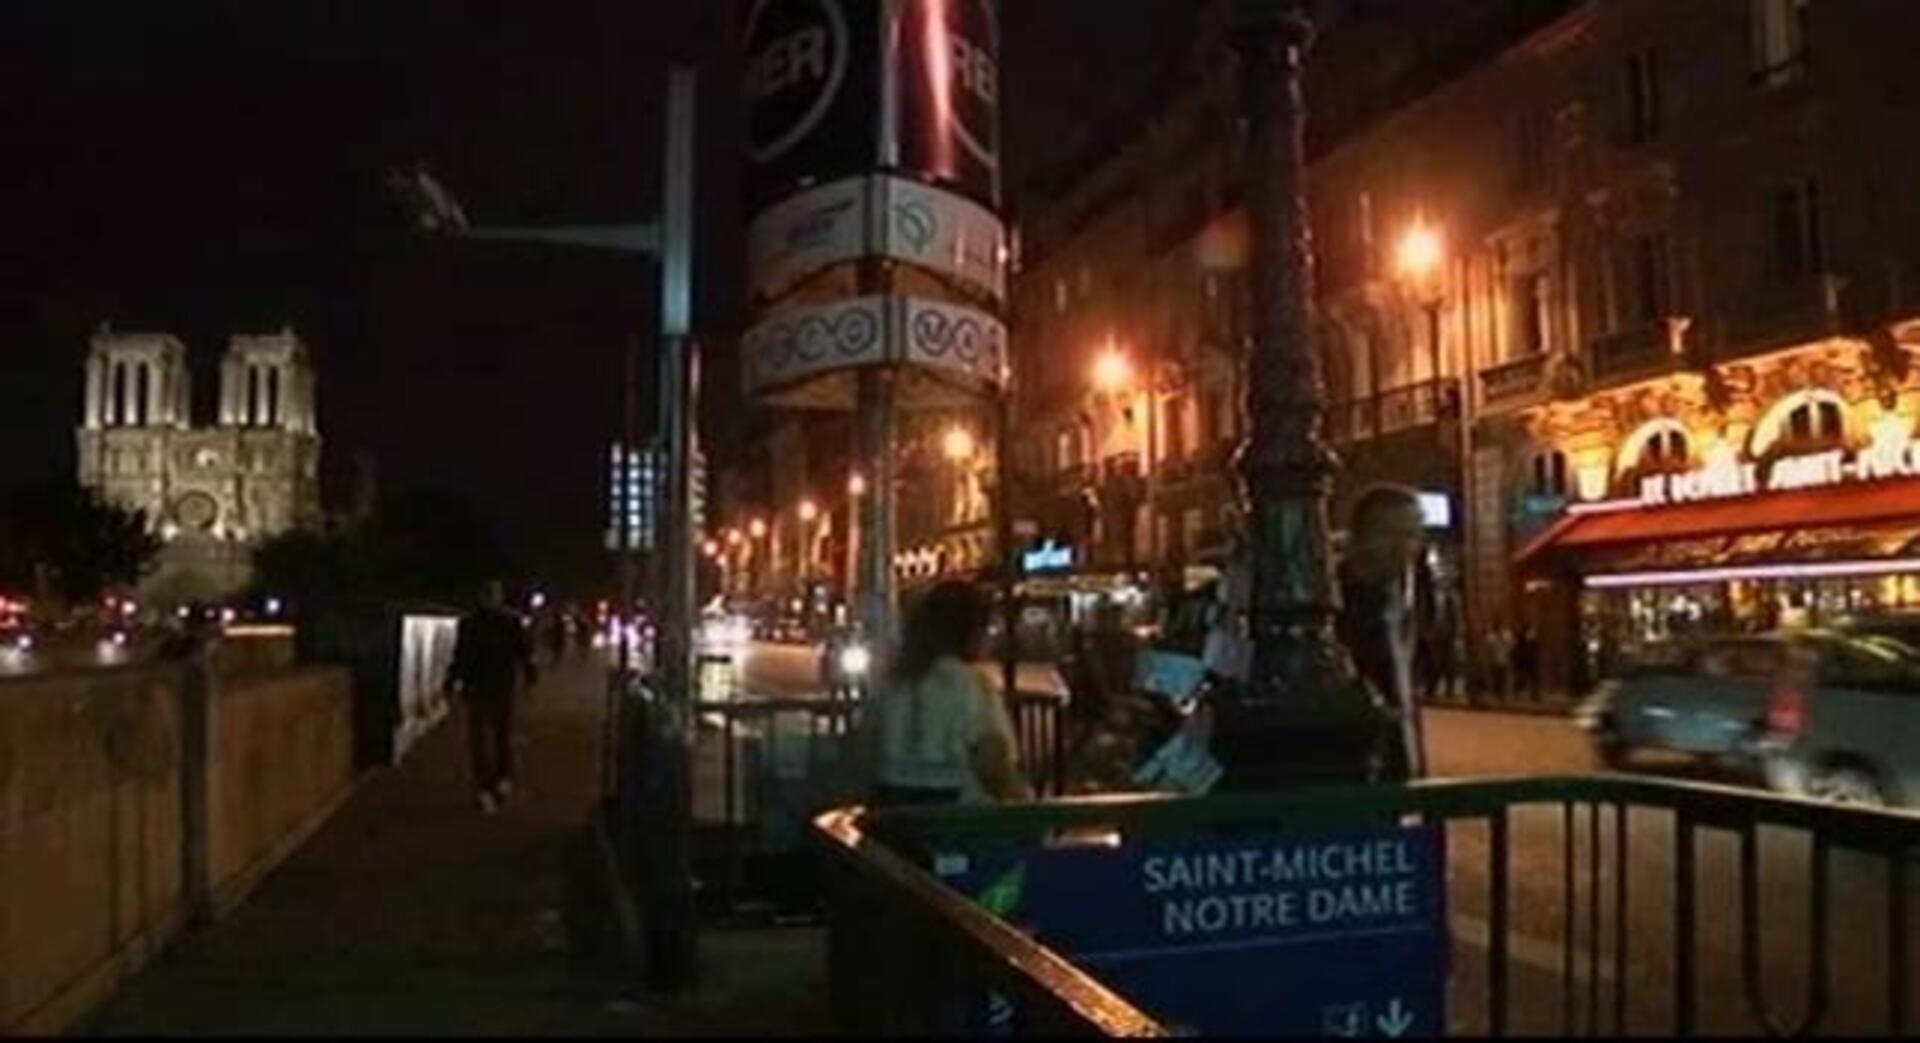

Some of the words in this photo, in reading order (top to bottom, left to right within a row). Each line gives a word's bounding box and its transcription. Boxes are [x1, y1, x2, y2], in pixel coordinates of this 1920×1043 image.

[1143, 842, 1416, 892] SAINT-MICHEL
[1163, 892, 1299, 934] NOTRE
[1307, 881, 1416, 923] DAME
